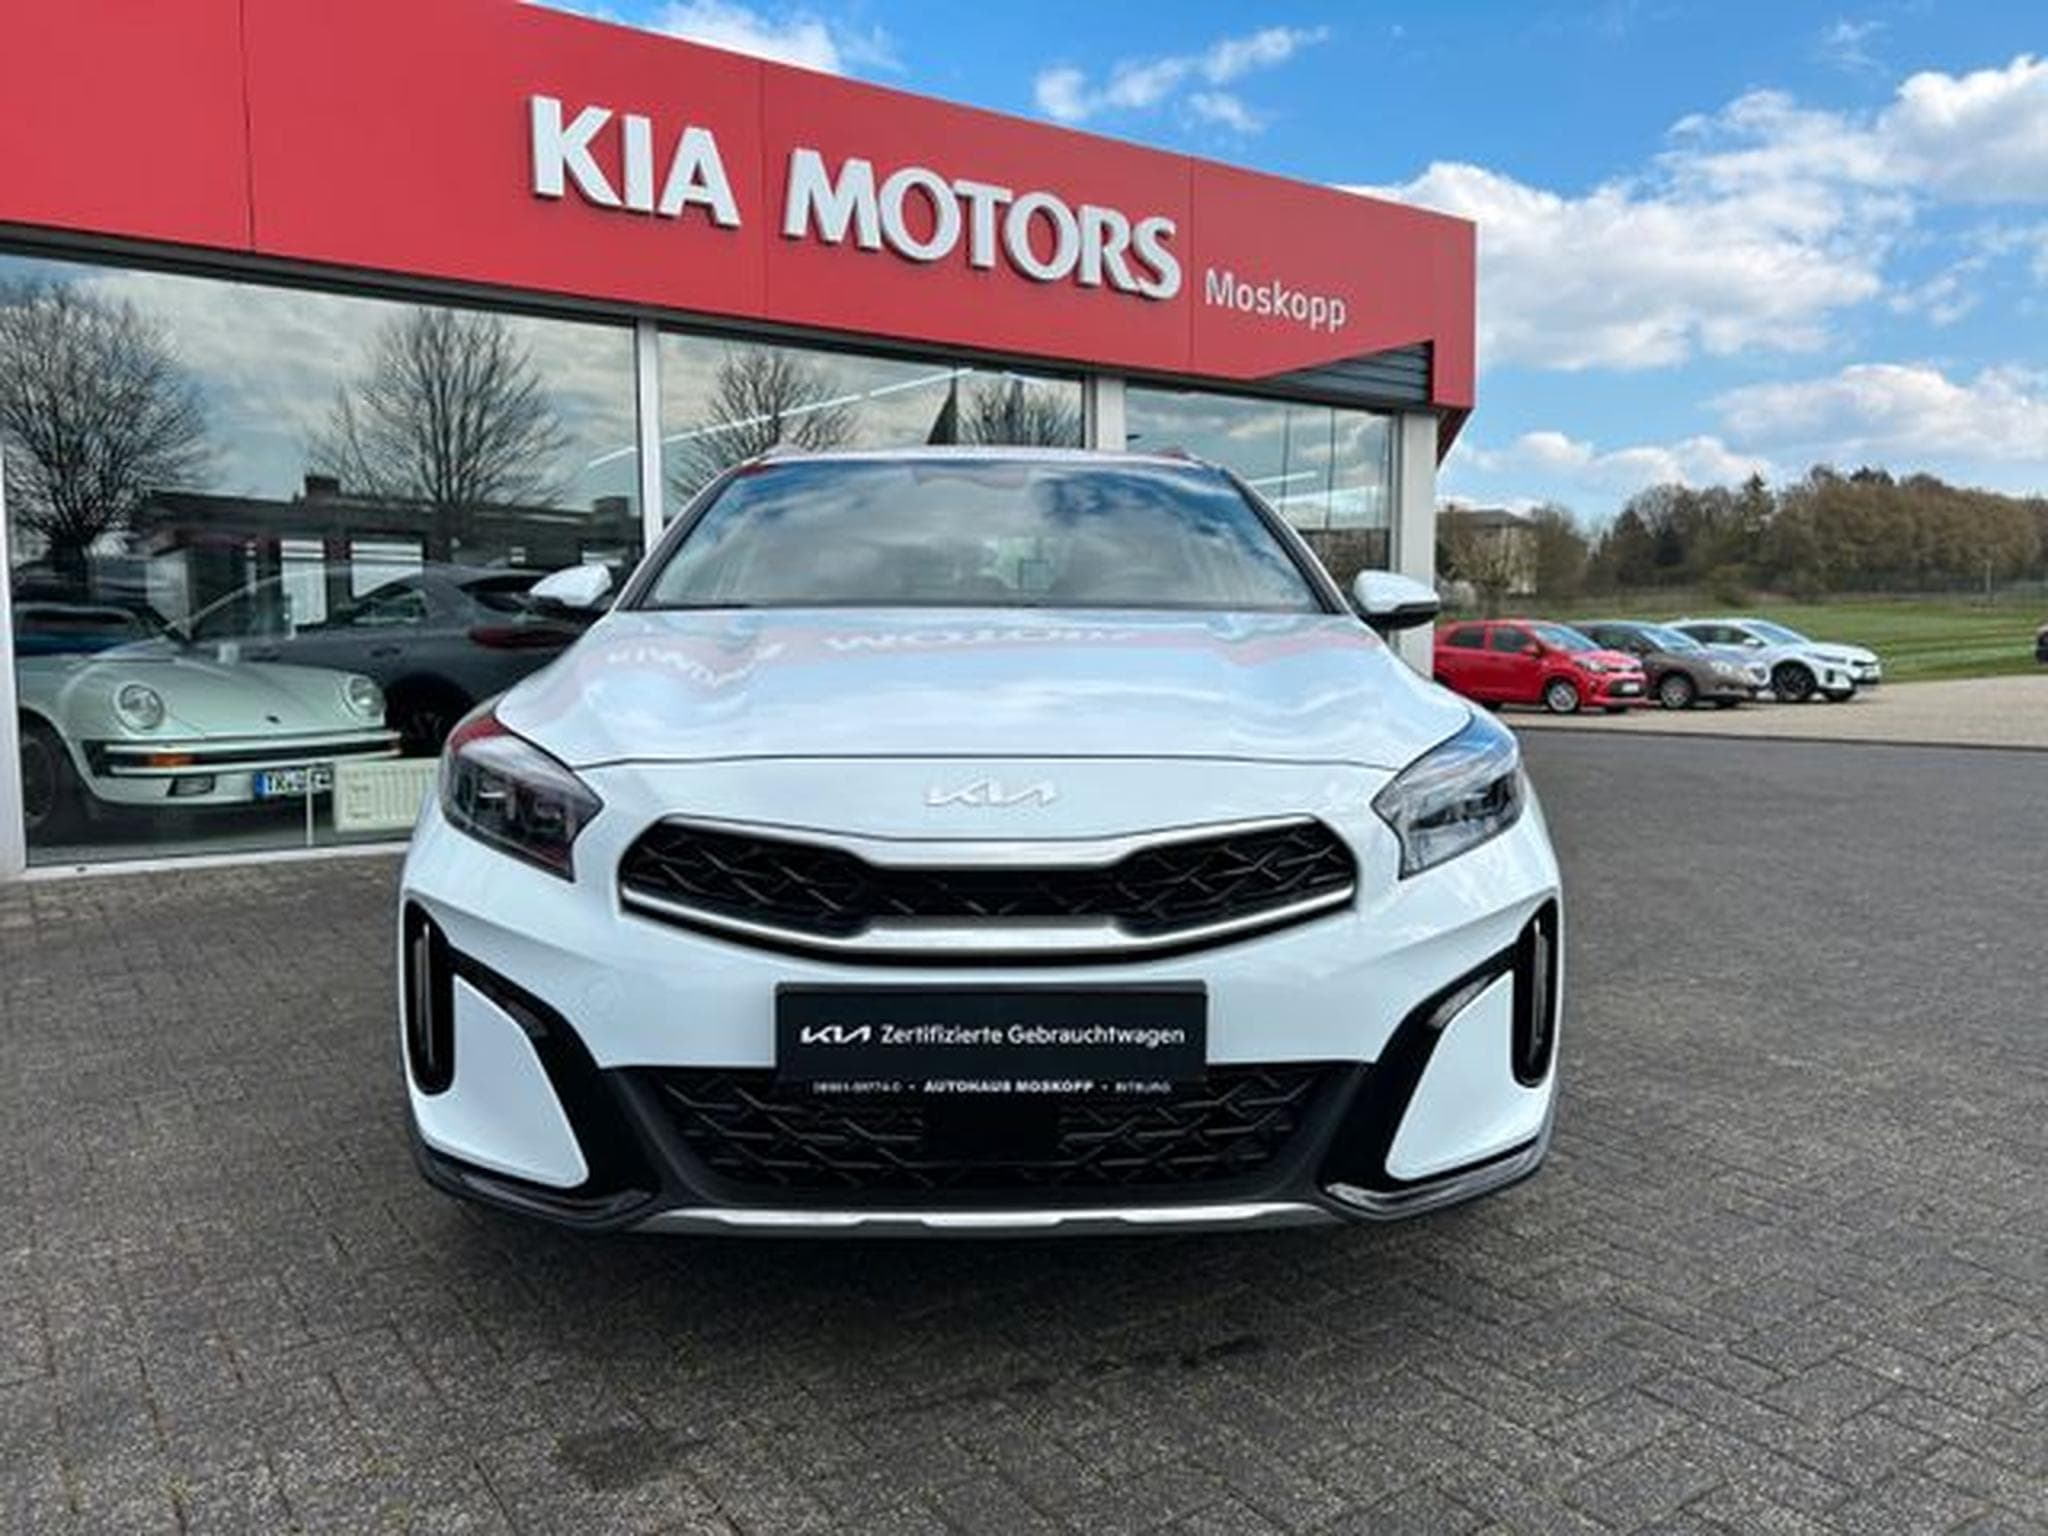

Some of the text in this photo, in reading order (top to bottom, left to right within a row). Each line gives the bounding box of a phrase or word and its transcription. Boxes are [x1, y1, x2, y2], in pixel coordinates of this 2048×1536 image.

[528, 94, 1184, 302] KIA MOTORS
[1204, 267, 1347, 331] Moskopp
[881, 1024, 1003, 1044] Zertifizierte
[1007, 1024, 1185, 1048] Gebrauchtwagen
[923, 1080, 1011, 1093] AUTOHAUS
[1015, 1080, 1094, 1093] MOSKOPP
